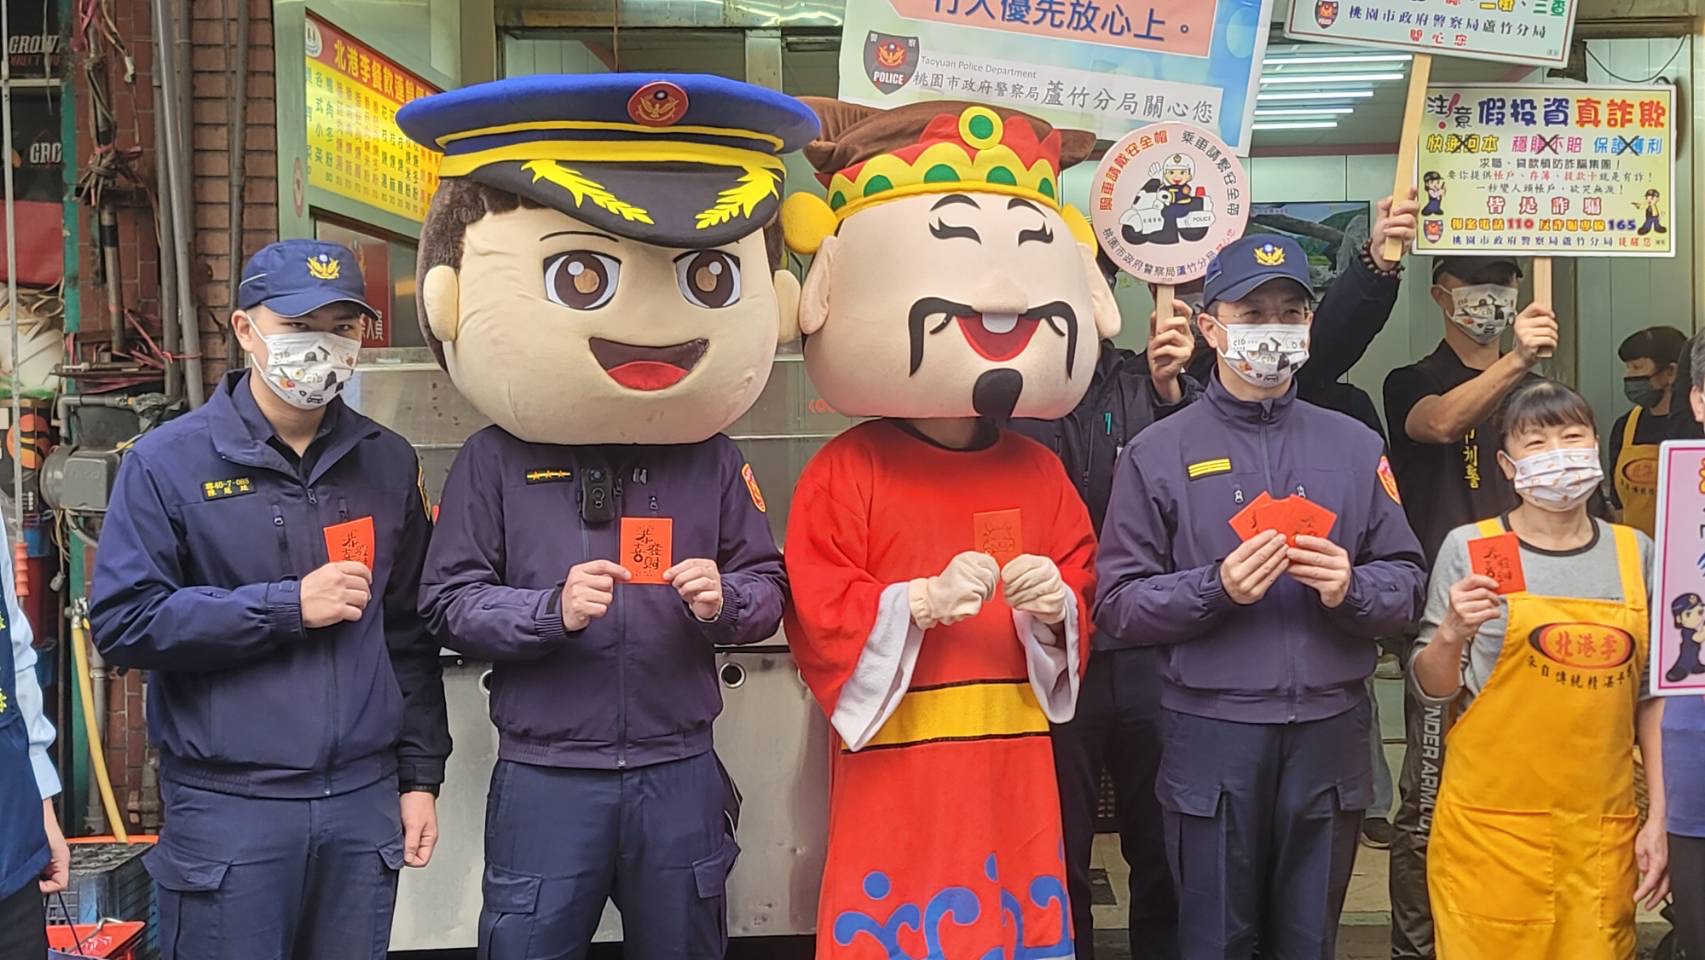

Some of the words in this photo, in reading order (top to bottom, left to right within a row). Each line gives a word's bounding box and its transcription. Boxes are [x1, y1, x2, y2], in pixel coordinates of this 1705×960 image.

[1349, 5, 1546, 39] 桃園市政府警察局蘆竹分局
[873, 71, 904, 86] POLICE
[921, 56, 957, 69] Taoyuan
[958, 61, 983, 73] Police
[985, 64, 1037, 80] Department
[1555, 631, 1618, 660] 北港李
